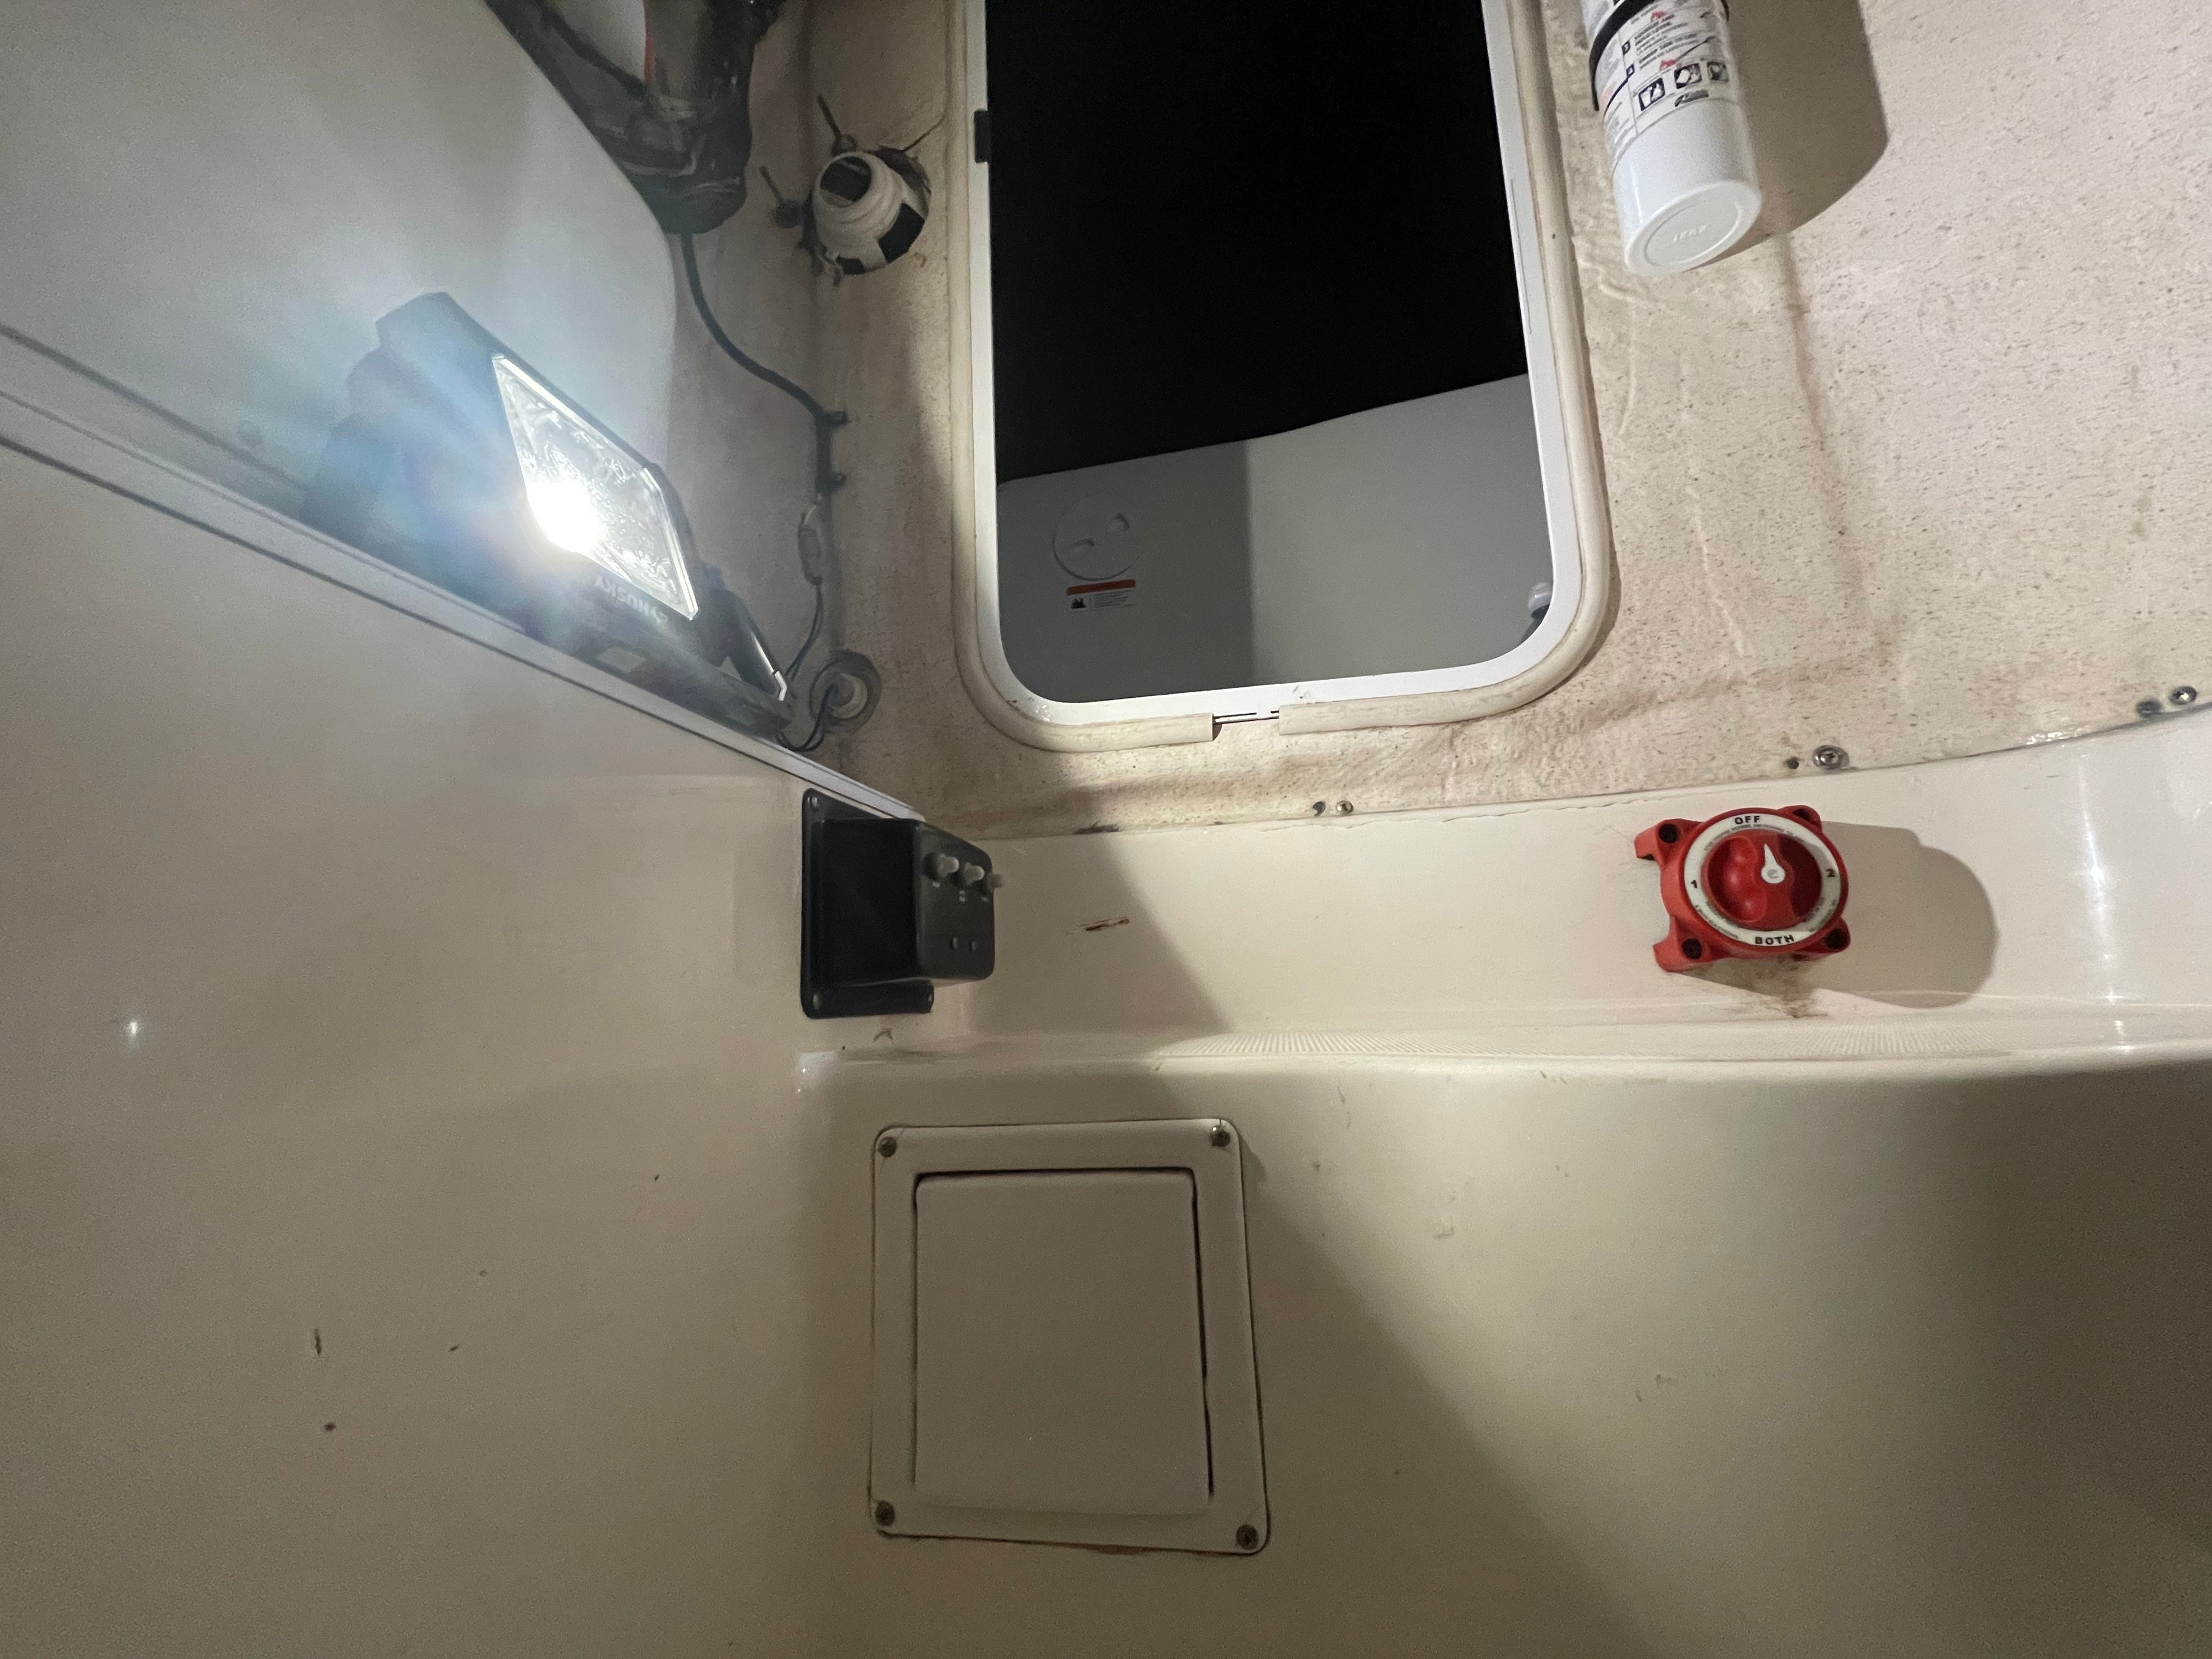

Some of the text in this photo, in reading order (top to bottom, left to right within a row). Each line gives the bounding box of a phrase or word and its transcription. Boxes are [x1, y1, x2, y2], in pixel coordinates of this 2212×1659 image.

[594, 574, 650, 617] HUSKY
[1735, 815, 1760, 825] OFF
[1826, 868, 1836, 878] 2
[1690, 879, 1698, 888] 1
[1755, 934, 1795, 945] BOTH
